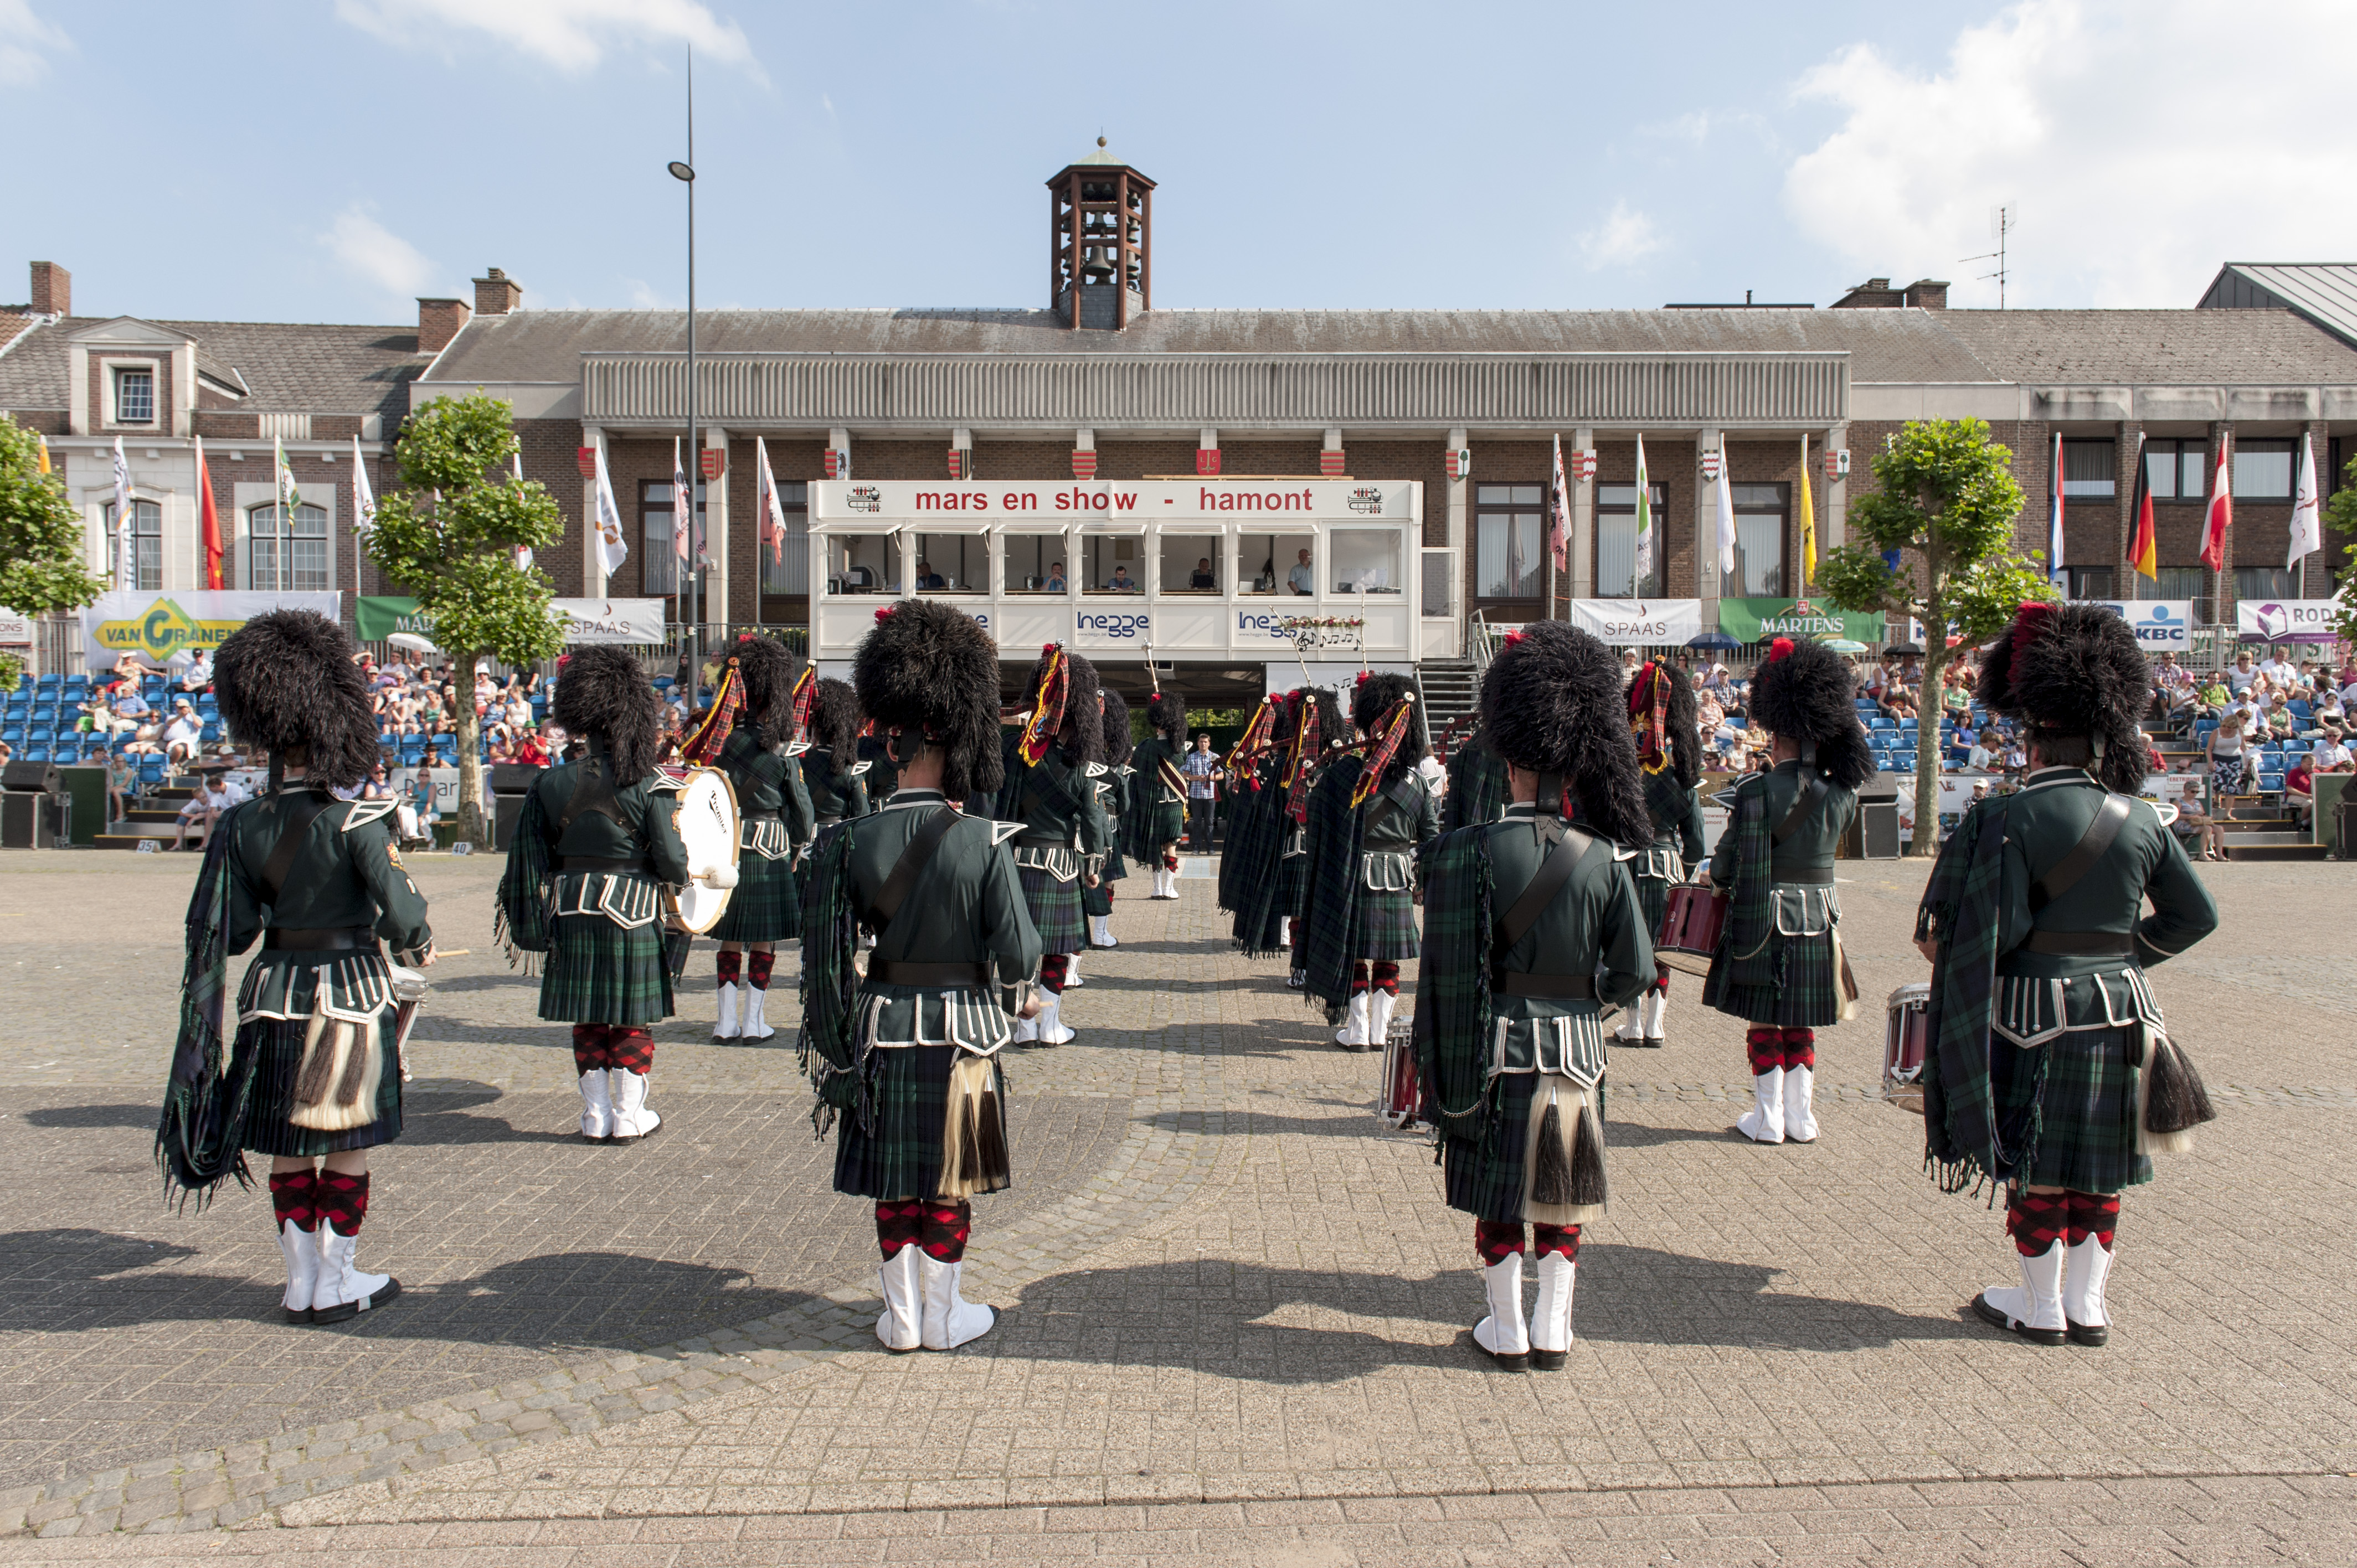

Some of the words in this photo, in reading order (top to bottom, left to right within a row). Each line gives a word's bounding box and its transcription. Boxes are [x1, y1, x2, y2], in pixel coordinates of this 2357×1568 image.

[916, 493, 988, 510] mars
[1003, 493, 1037, 510] en
[1055, 487, 1137, 510] show
[1200, 487, 1313, 510] hamont
[2293, 608, 2338, 622] ROD
[571, 621, 630, 635] SPAAS
[1078, 612, 1149, 637] hegge
[1605, 622, 1666, 636] SPAAS
[1760, 617, 1844, 632] MARTENS
[106, 628, 141, 642] VAN
[2136, 628, 2184, 640] KBC
[711, 790, 727, 834] Premier
[138, 841, 153, 852] 35
[454, 843, 466, 853] 40
